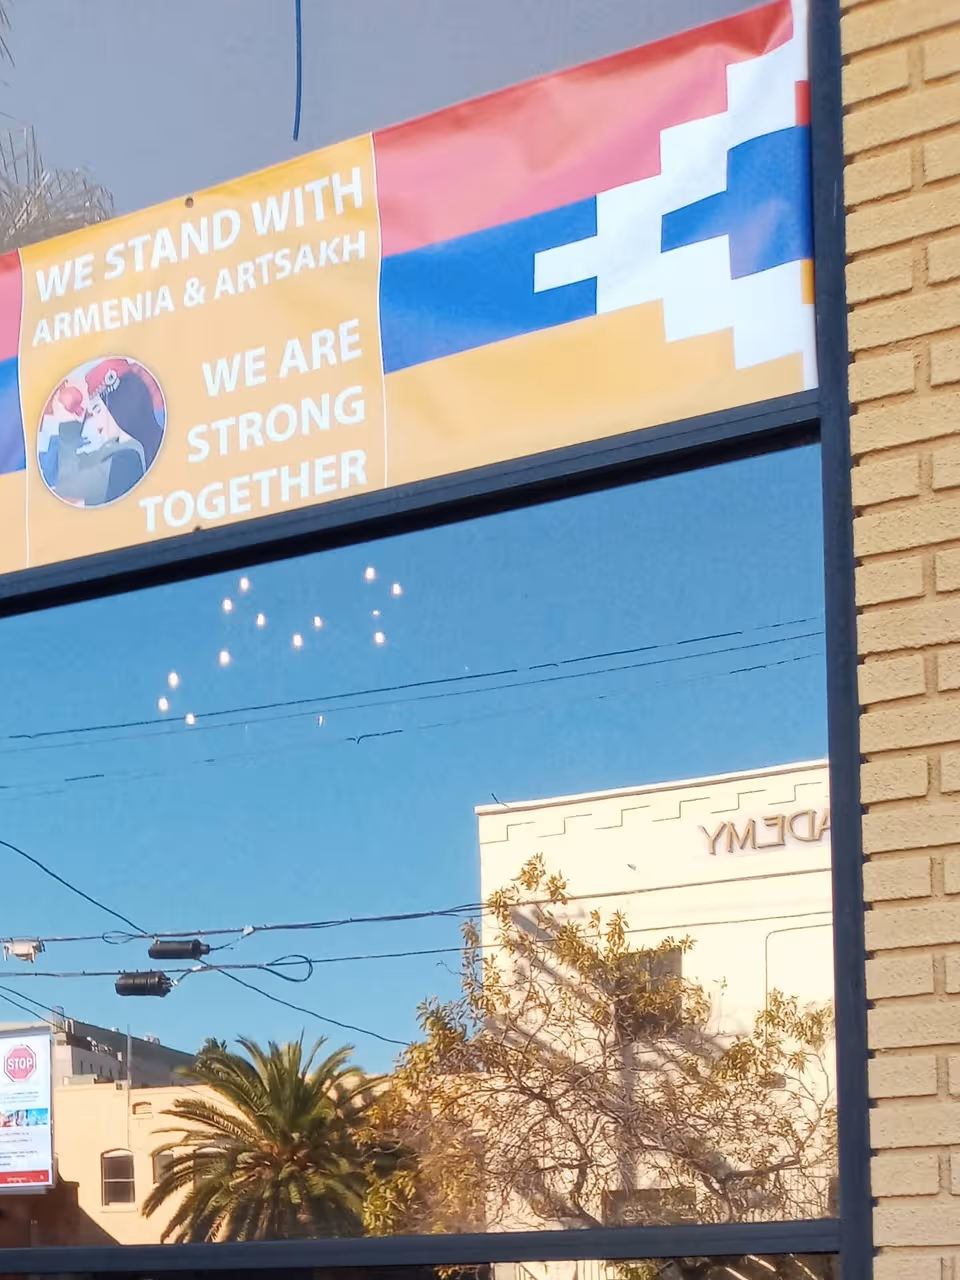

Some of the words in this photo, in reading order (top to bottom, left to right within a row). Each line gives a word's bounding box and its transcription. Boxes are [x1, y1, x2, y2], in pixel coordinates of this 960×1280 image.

[35, 253, 93, 303] WE
[104, 208, 240, 281] STAND
[251, 166, 363, 236] WITH
[32, 285, 175, 347] ARMENIA
[183, 277, 206, 309] &
[214, 230, 366, 301] ARTSAKH
[201, 345, 266, 397] WE
[278, 318, 362, 378] ARE
[187, 385, 365, 464] STRONG
[139, 449, 367, 532] TOGETHER
[7, 1057, 33, 1070] STOP
